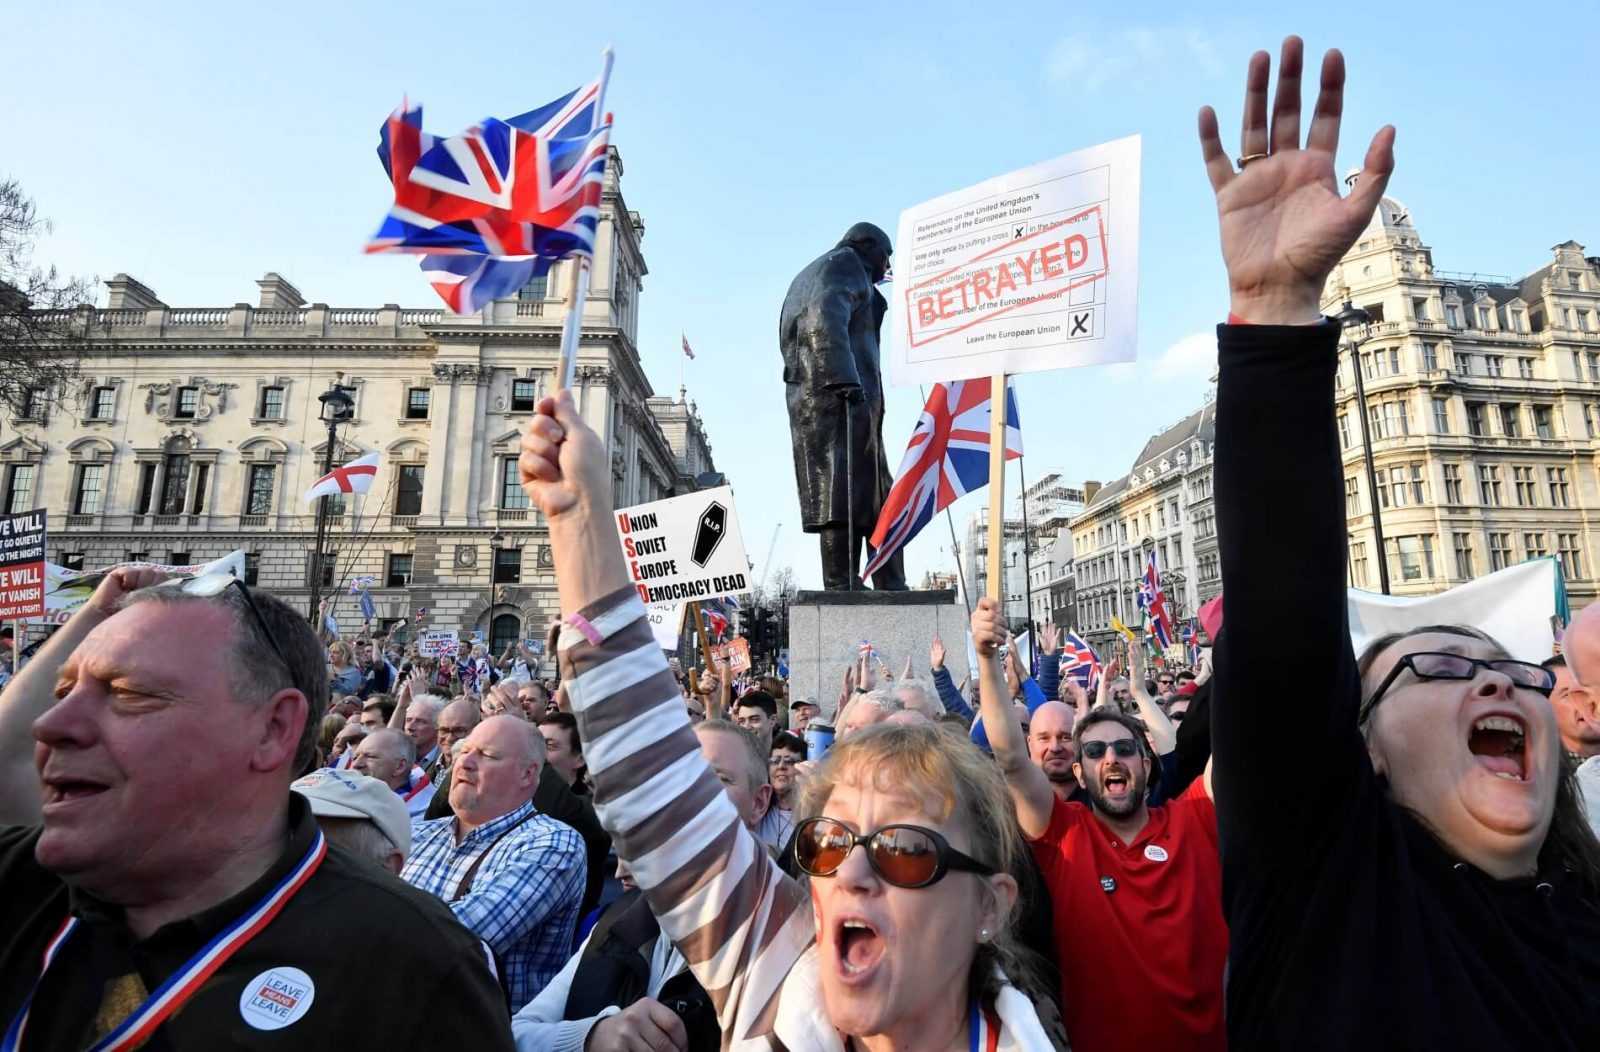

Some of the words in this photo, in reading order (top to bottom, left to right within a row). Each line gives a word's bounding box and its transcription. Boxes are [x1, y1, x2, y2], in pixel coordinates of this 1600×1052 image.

[954, 213, 963, 222] on
[964, 210, 975, 218] the
[976, 202, 999, 215] United
[999, 192, 1040, 208] Kingdom's
[954, 223, 962, 232] of
[962, 219, 973, 229] the
[974, 211, 1008, 225] European
[1009, 205, 1032, 216] Union
[918, 233, 1089, 328] BETRAYED
[966, 335, 984, 345] Leave
[985, 333, 997, 341] the
[998, 329, 1035, 340] European
[1037, 325, 1061, 335] Union
[12, 513, 43, 534] WILL
[618, 512, 658, 534] UNION
[704, 516, 721, 534] R.I.P.
[4, 538, 14, 549] GO
[15, 533, 43, 547] QUIETLY
[624, 536, 668, 559] SOVIET
[5, 550, 19, 561] THE
[11, 567, 41, 587] WILL
[630, 559, 678, 581] EUROPE
[8, 587, 41, 603] VANISH
[636, 578, 712, 604] DEMOCRACY
[713, 573, 746, 593] DEAD
[16, 605, 22, 615] A
[266, 978, 305, 998] LEAVE
[251, 997, 290, 1018] LEAVE
